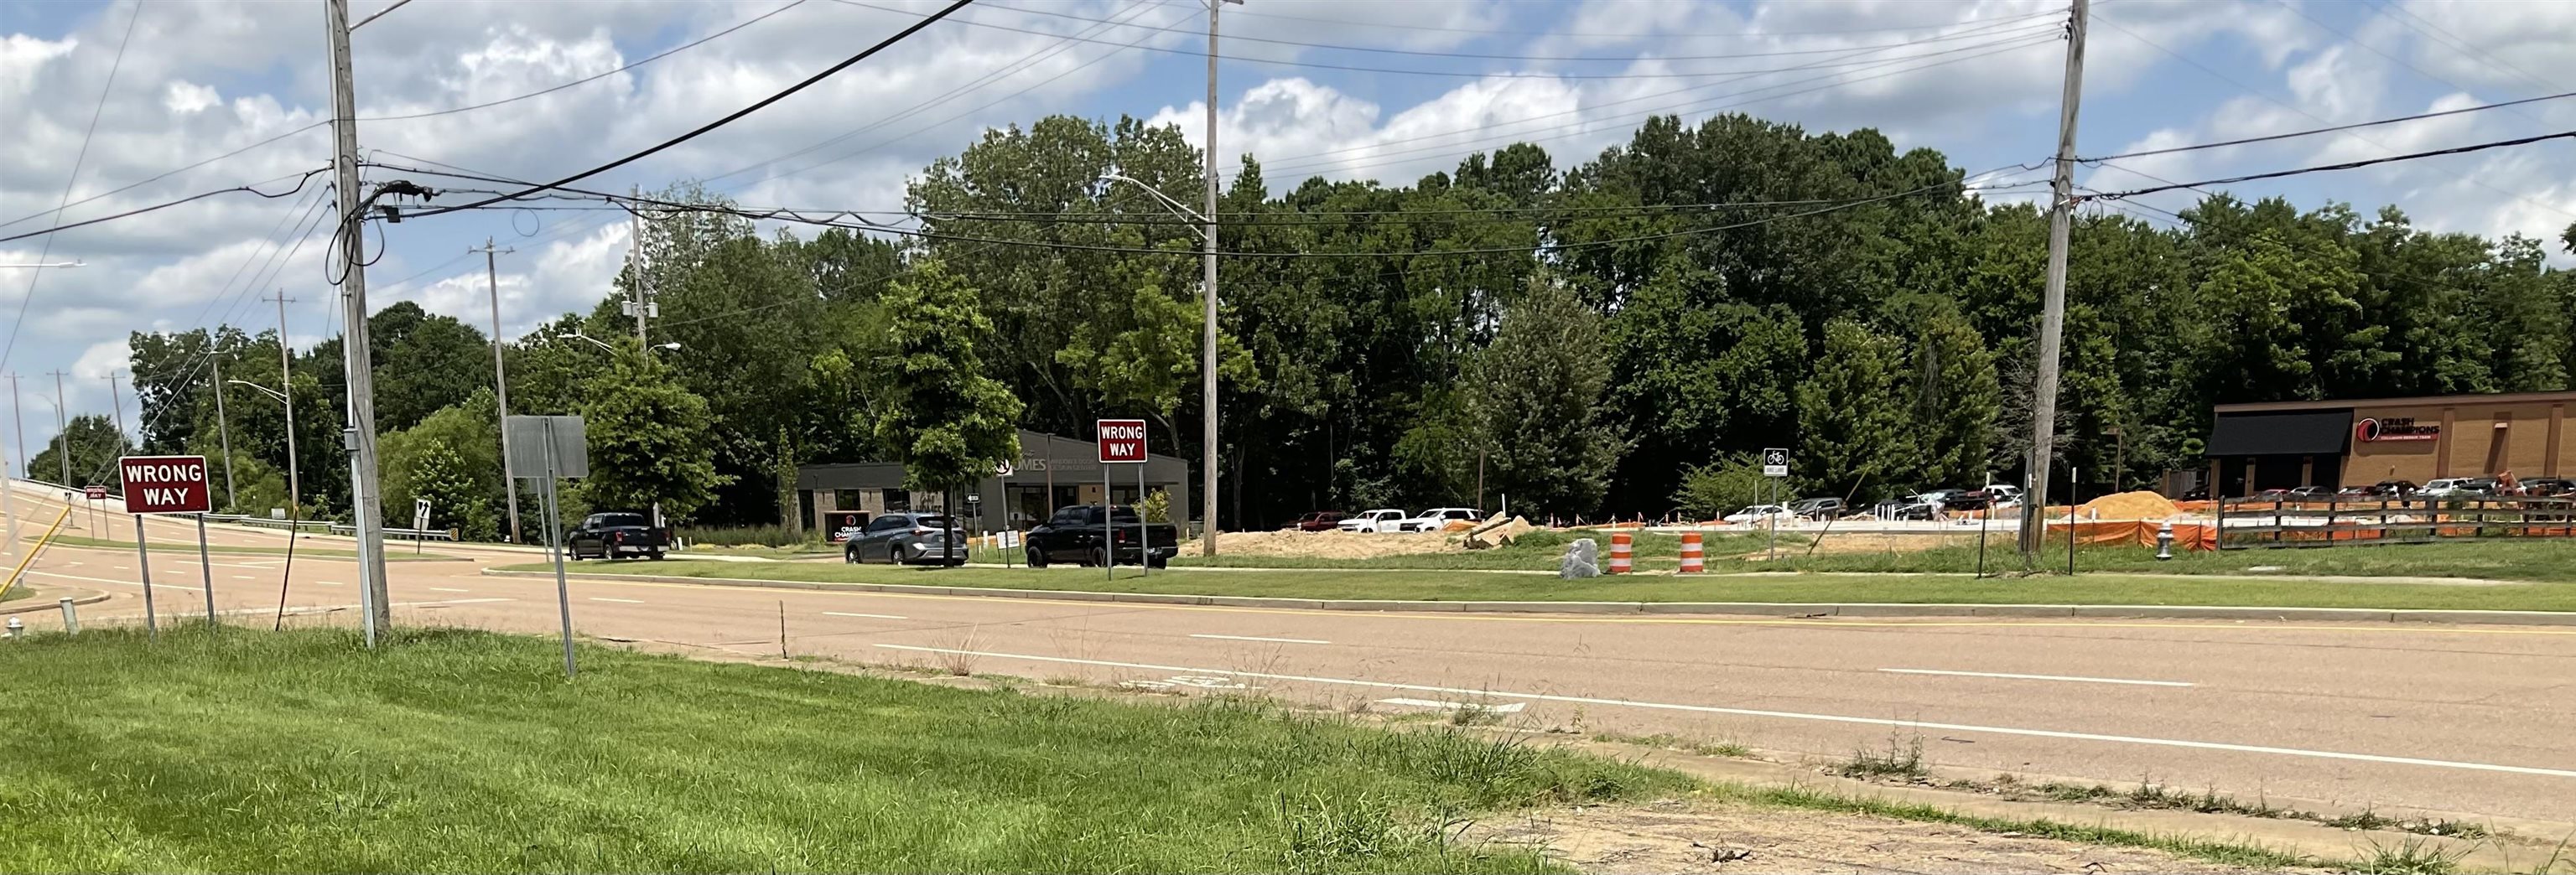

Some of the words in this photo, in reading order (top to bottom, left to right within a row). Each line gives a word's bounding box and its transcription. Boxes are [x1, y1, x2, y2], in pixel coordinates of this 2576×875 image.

[2381, 417, 2414, 426] CRASH
[1101, 426, 1143, 439] WRONG
[1109, 443, 1135, 456] WAY
[1012, 458, 1046, 471] OMES
[126, 464, 202, 483] WRONG
[143, 488, 189, 505] WAY
